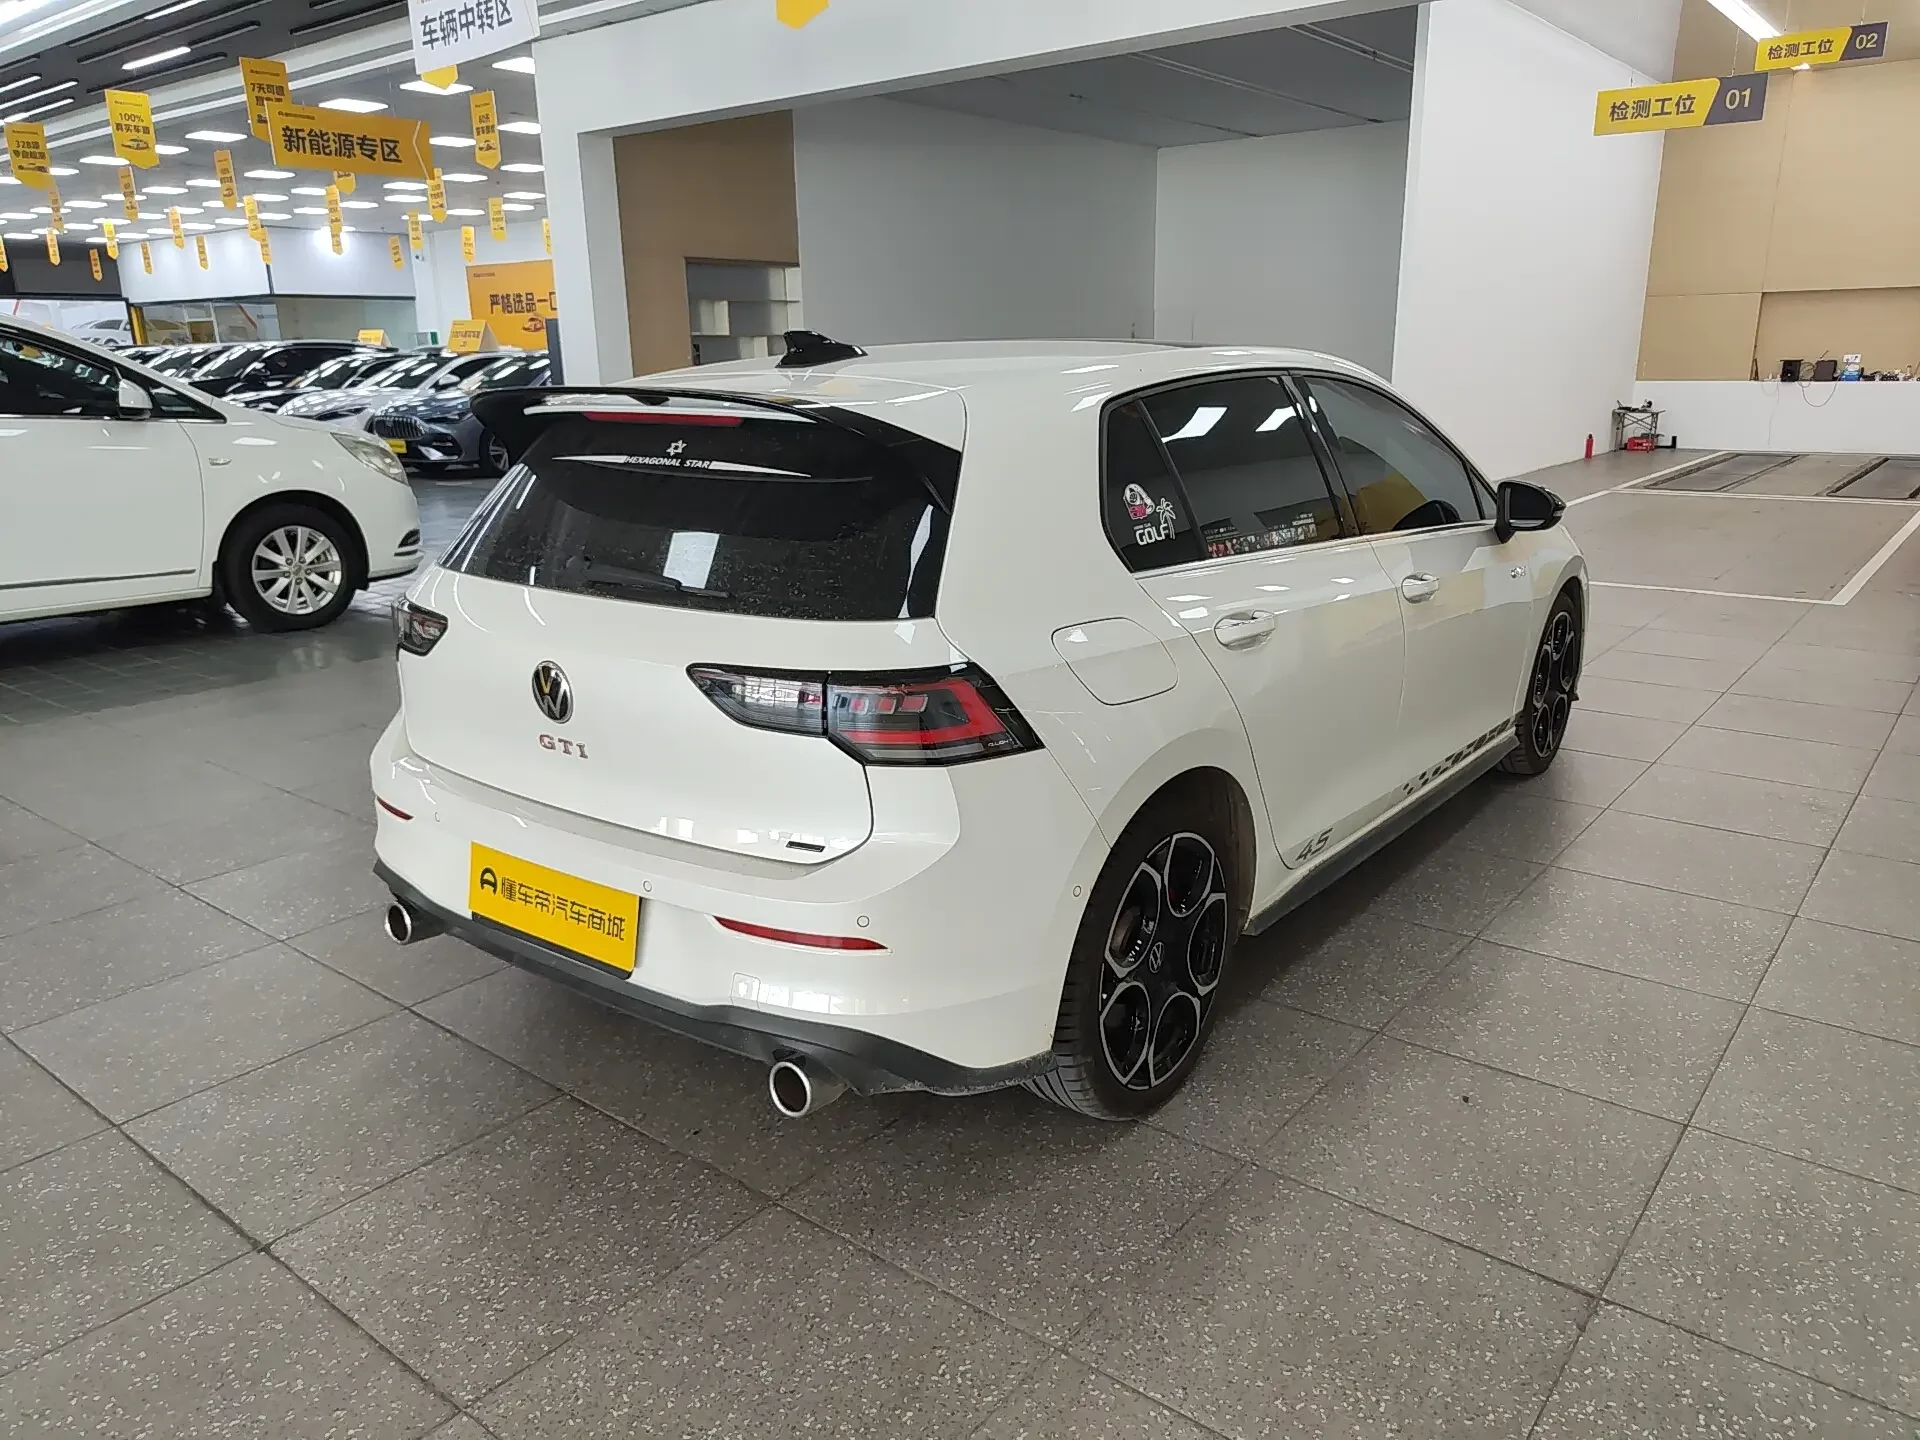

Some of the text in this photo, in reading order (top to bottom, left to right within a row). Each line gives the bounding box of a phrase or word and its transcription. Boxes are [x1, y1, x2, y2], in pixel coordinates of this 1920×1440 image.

[420, 0, 513, 50] 车辆中转区
[1767, 33, 1878, 61] 检测工位 02
[118, 112, 144, 123] 100%
[1609, 88, 1752, 122] 检测工位 01
[281, 125, 402, 163] 新能源专区
[624, 455, 710, 469] HEXAGONAL STAR
[1135, 523, 1169, 546] GOLF
[539, 733, 589, 760] GTI
[1295, 827, 1334, 862] 45
[501, 876, 626, 942] 懂车帝汽车商城
